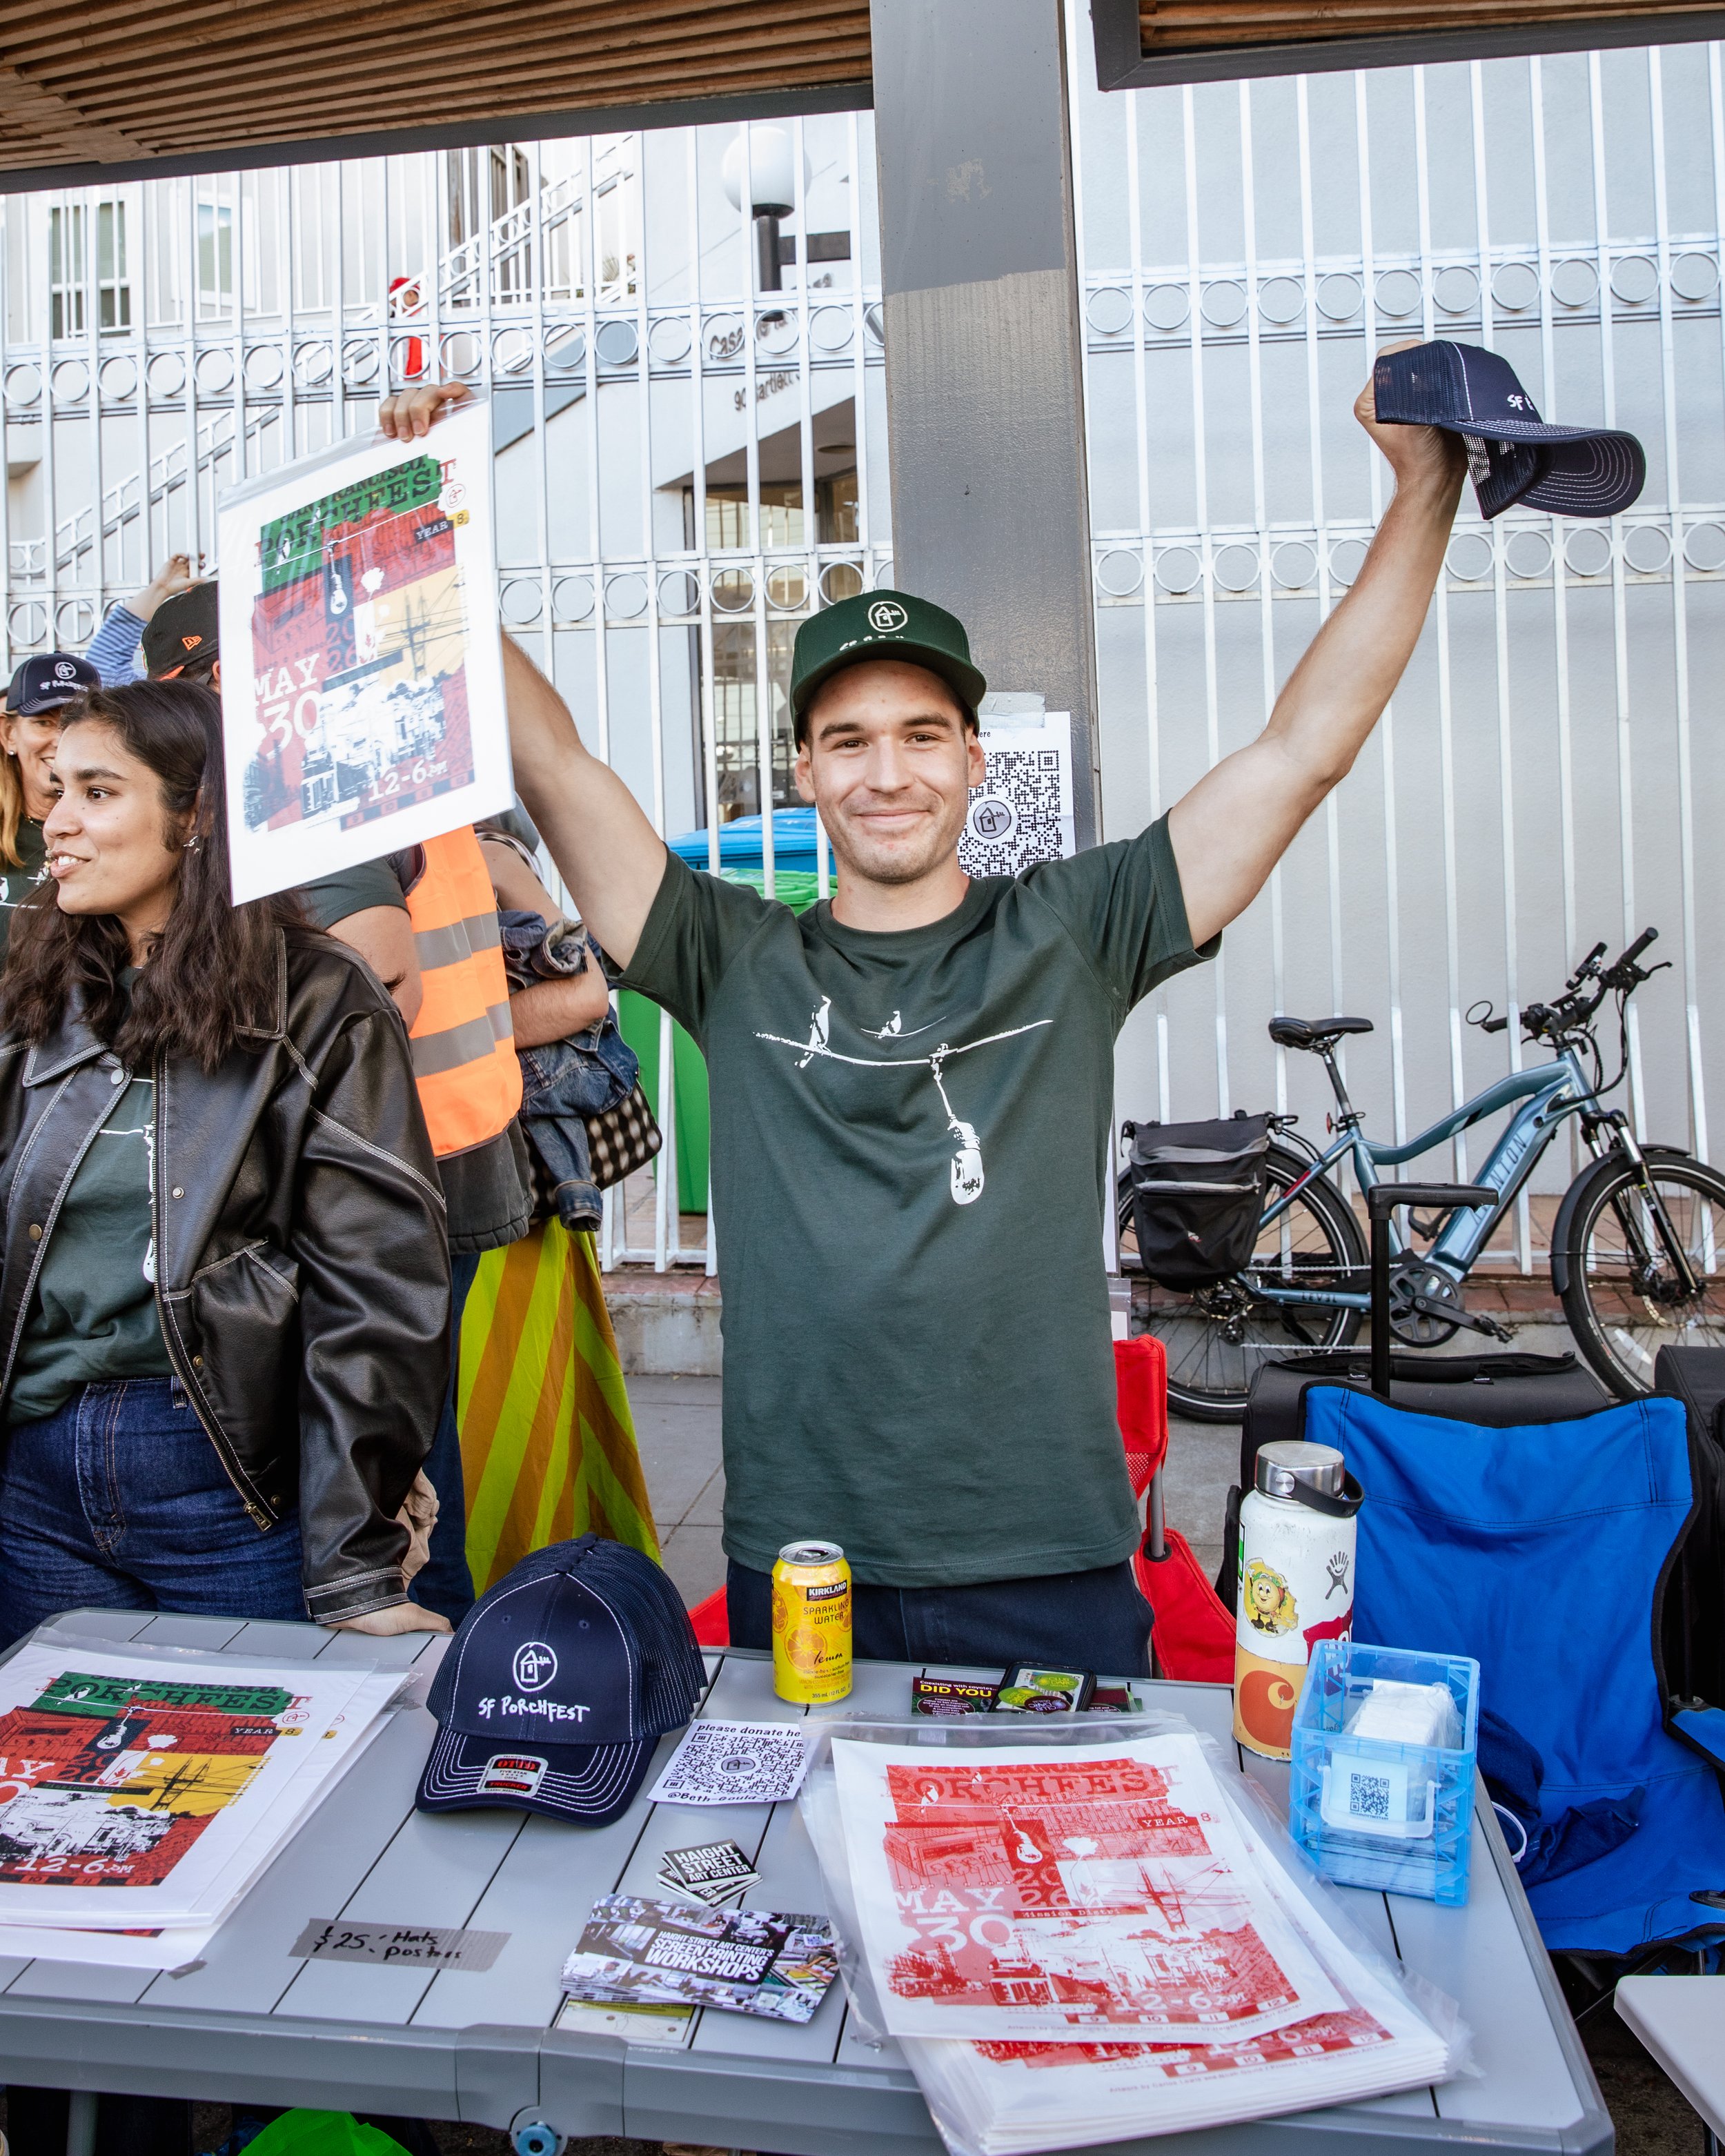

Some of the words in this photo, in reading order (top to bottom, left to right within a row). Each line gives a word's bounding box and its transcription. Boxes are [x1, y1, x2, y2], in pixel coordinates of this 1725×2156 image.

[1506, 395, 1523, 411] SF
[415, 521, 448, 540] YEAR
[253, 653, 320, 706] MAY
[264, 691, 323, 759] 30
[1468, 1133, 1527, 1225] ANTON
[809, 1581, 847, 1596] KIRKLAND
[803, 1599, 849, 1615] SPARKLING
[814, 1612, 844, 1625] WATER
[814, 1650, 843, 1665] lemon
[35, 1677, 313, 1710] PORCHFEST
[920, 1684, 951, 1694] DID
[956, 1688, 992, 1697] YOU
[478, 1697, 496, 1719] SF
[697, 1724, 737, 1733] please
[740, 1726, 783, 1737] donate
[497, 1760, 535, 1770] OTTO
[878, 1764, 1183, 1798] PORCHFEST
[1142, 1817, 1188, 1828] YEAR
[673, 1843, 732, 1863] HAIGHT
[681, 1852, 745, 1874] STREET
[689, 1870, 710, 1882] ART
[711, 1864, 751, 1879] CENTER
[896, 1887, 1005, 1915] MAY
[1023, 1910, 1072, 1919] Mission
[392, 1930, 438, 1946] Hats
[916, 1913, 1018, 1954] 30
[651, 1937, 707, 1957] SCREEN
[706, 1946, 769, 1967] PRINTING
[658, 1931, 689, 1944] HAIGHT
[688, 1936, 719, 1948] STREET
[718, 1941, 736, 1950] ART
[734, 1944, 775, 1958] CENTER'S
[644, 1948, 764, 1981] WORKSHOPS
